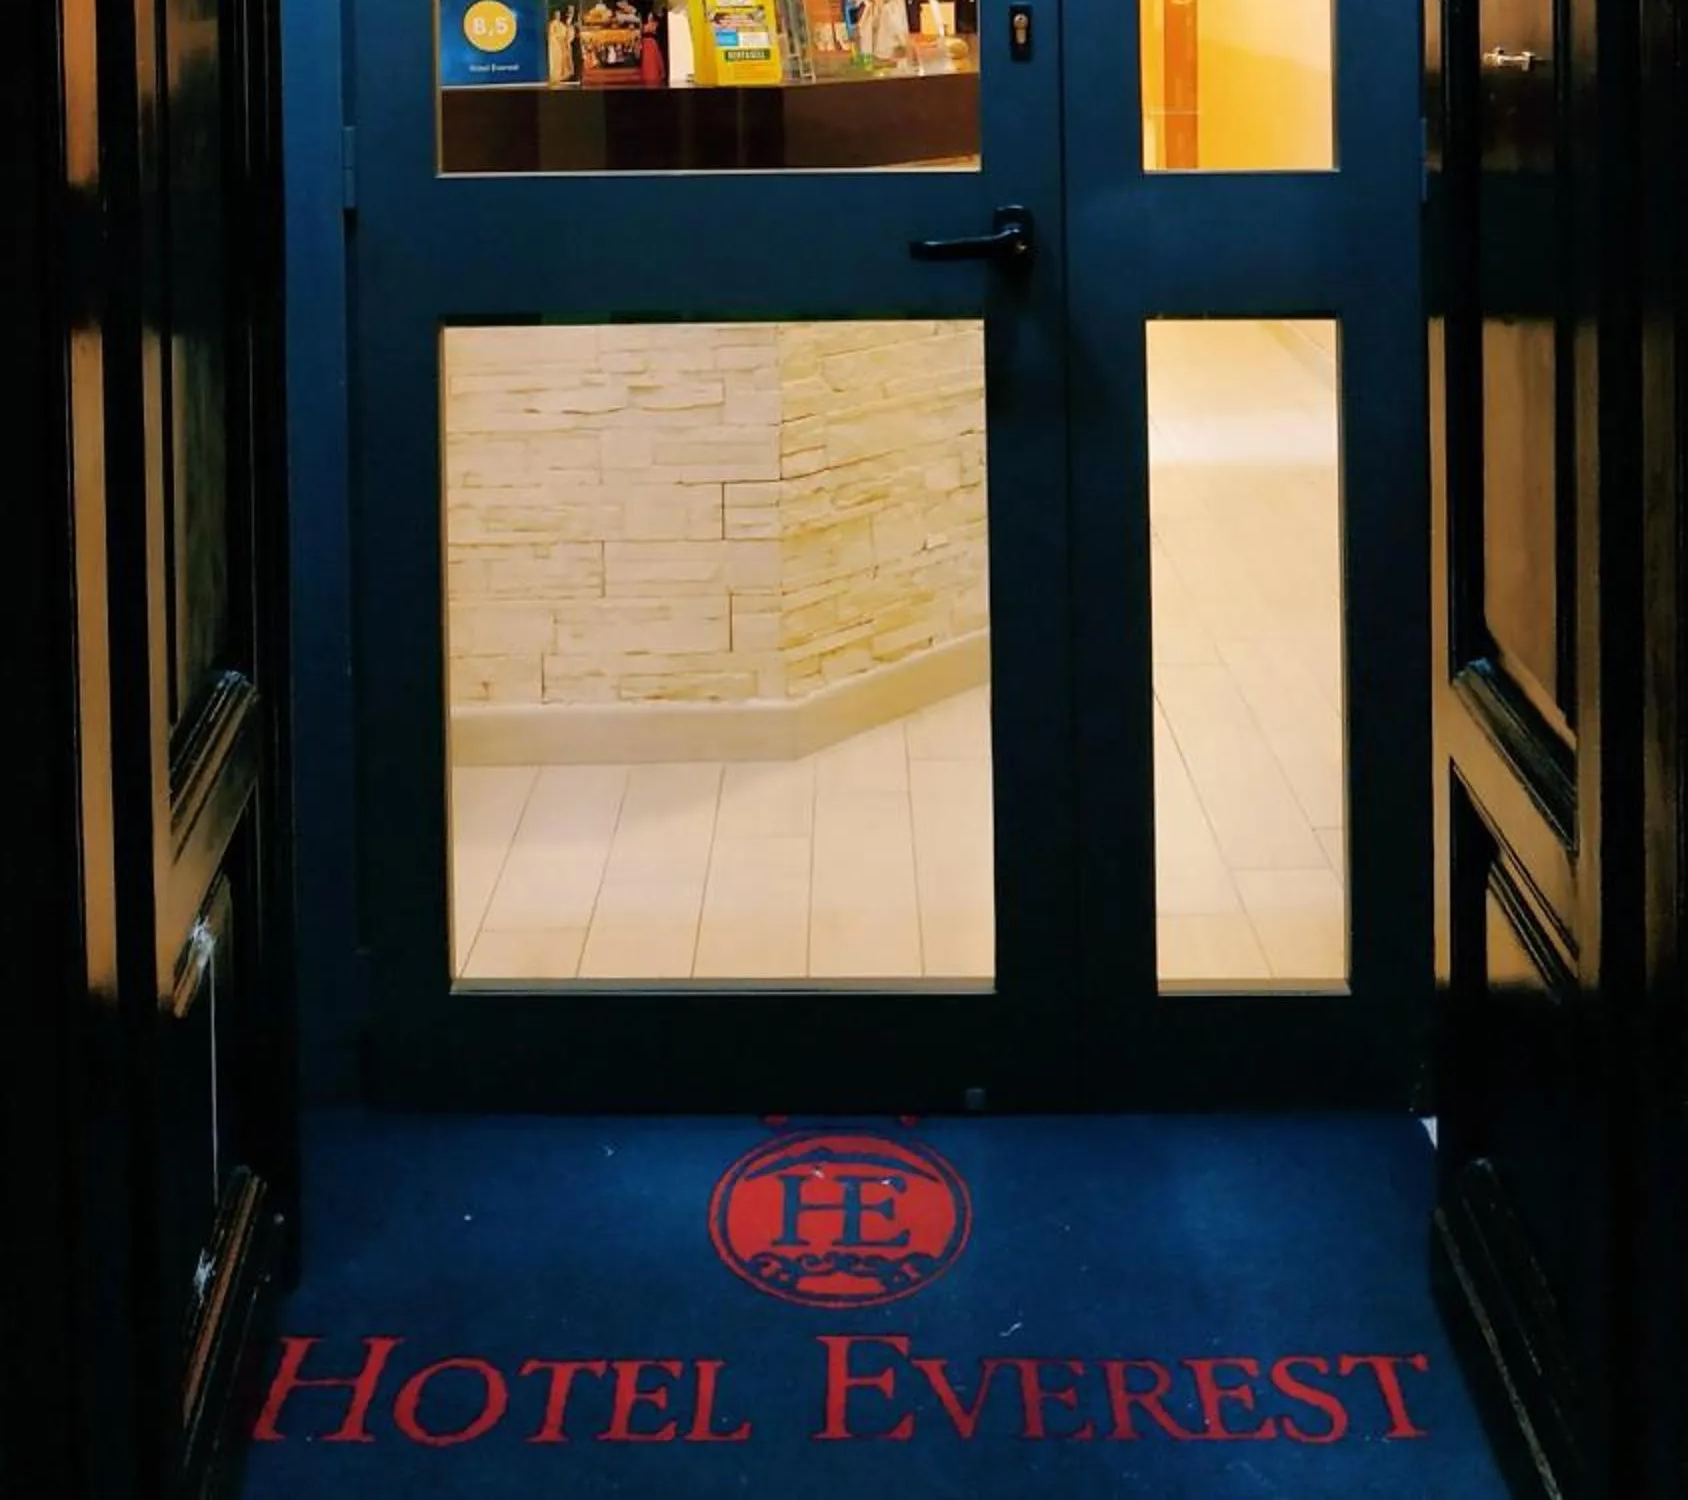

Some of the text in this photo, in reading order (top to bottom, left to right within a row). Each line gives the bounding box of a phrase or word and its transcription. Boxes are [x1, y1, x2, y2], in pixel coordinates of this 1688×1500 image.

[770, 1173, 912, 1248] HE
[252, 1333, 1430, 1447] HOTEL EVEREST
